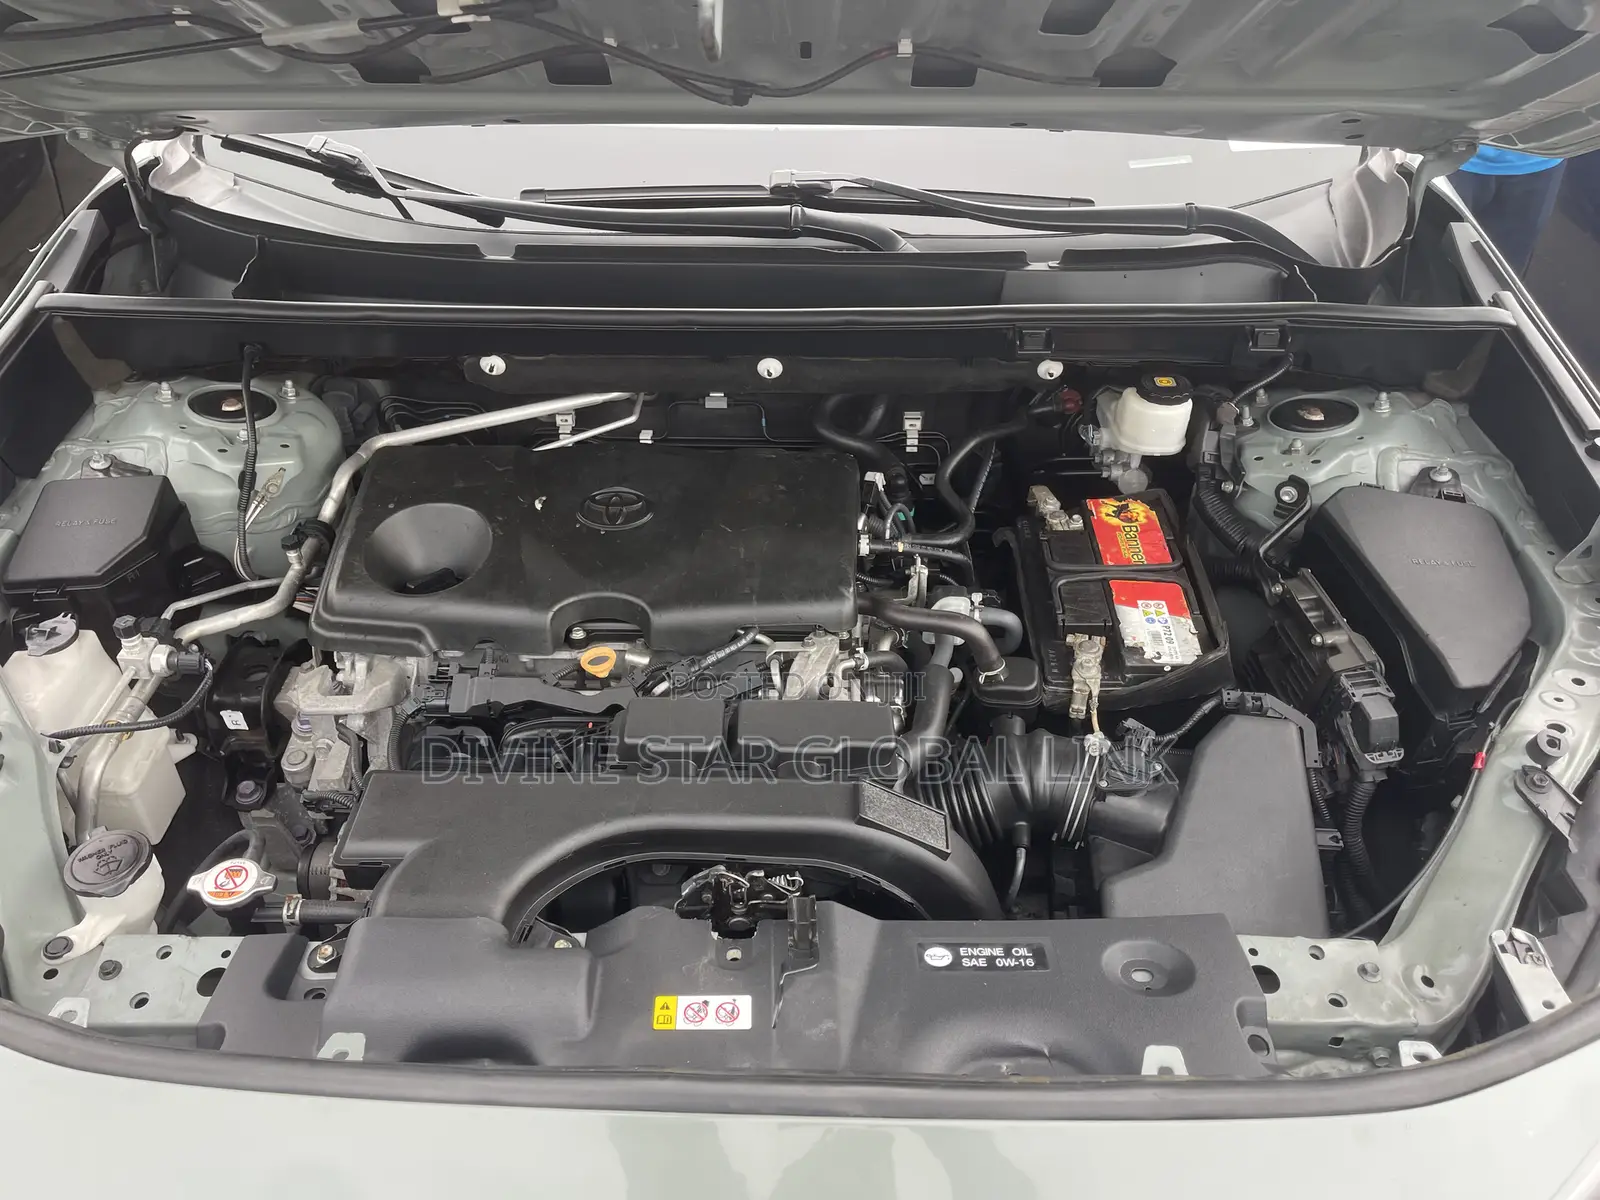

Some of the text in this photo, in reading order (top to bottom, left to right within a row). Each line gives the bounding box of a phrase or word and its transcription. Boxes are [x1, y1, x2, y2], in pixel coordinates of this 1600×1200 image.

[55, 519, 83, 527] RELAY
[93, 516, 117, 525] FUSE
[1121, 524, 1146, 565] Banner
[1409, 558, 1441, 566] RELAY
[960, 947, 1033, 956] ENGINE OIL
[962, 958, 1035, 967] SAE 0W-16
